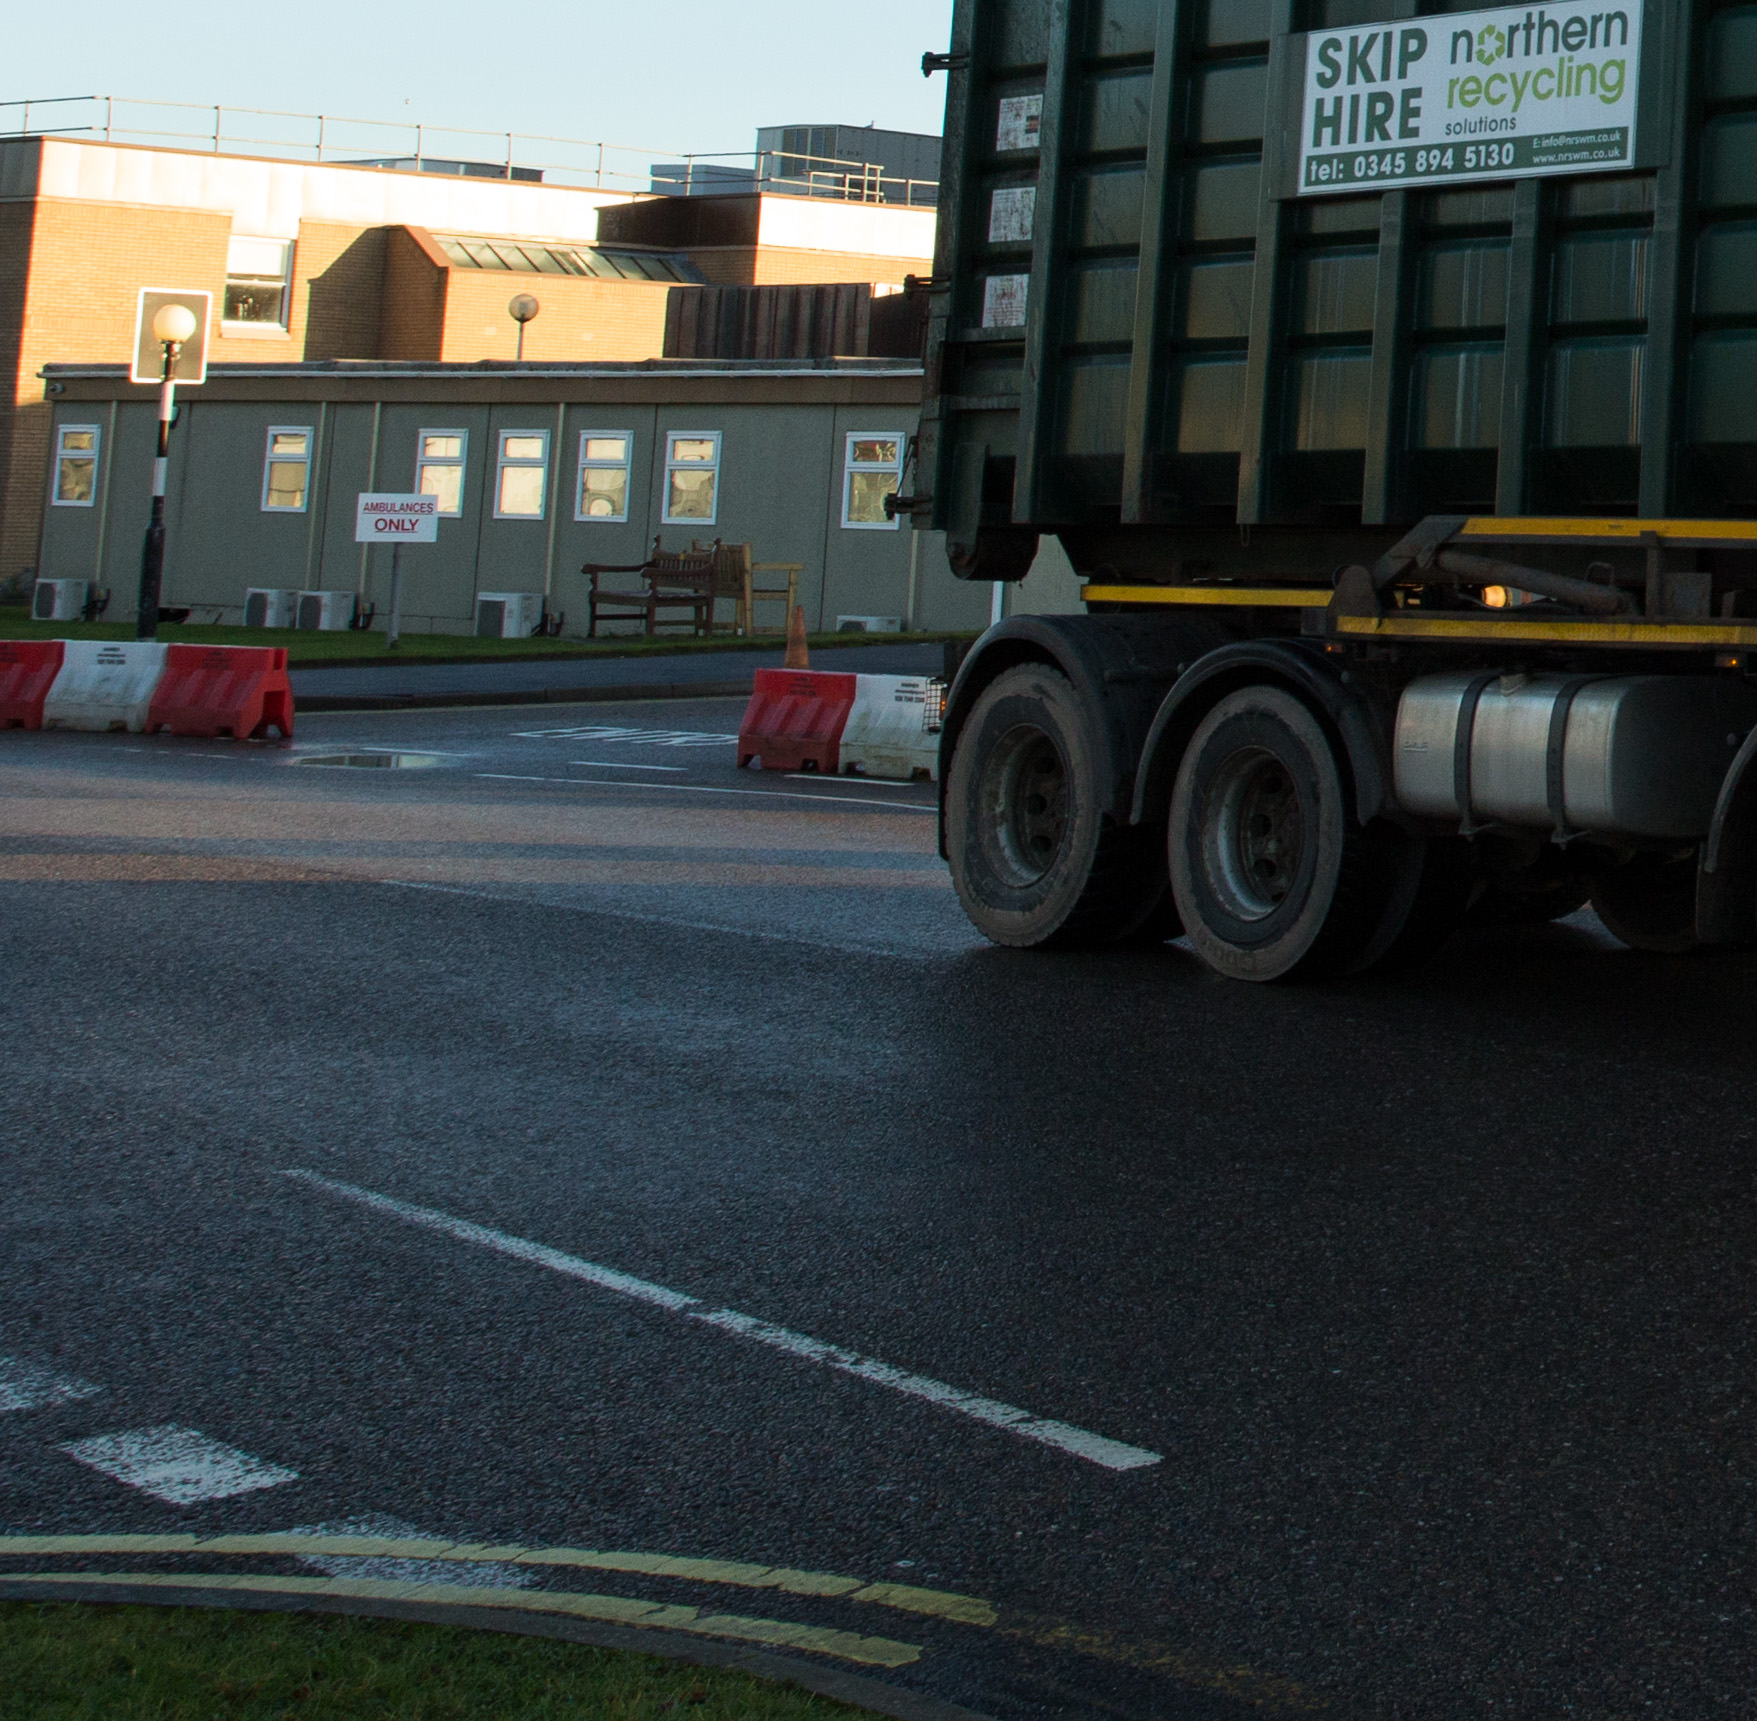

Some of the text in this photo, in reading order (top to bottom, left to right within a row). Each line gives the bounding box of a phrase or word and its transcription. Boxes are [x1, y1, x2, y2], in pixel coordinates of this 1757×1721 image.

[1450, 10, 1629, 66] northern
[1316, 28, 1428, 89] SKIP
[1446, 55, 1626, 113] recycling
[1312, 87, 1423, 148] HIRE
[1445, 116, 1517, 136] solutions
[1310, 142, 1515, 182] tel: 0345 894 5130
[1532, 146, 1620, 163] www.nrswm.co.uk
[363, 502, 434, 513] AMBULANCES
[374, 518, 420, 531] ONLY
